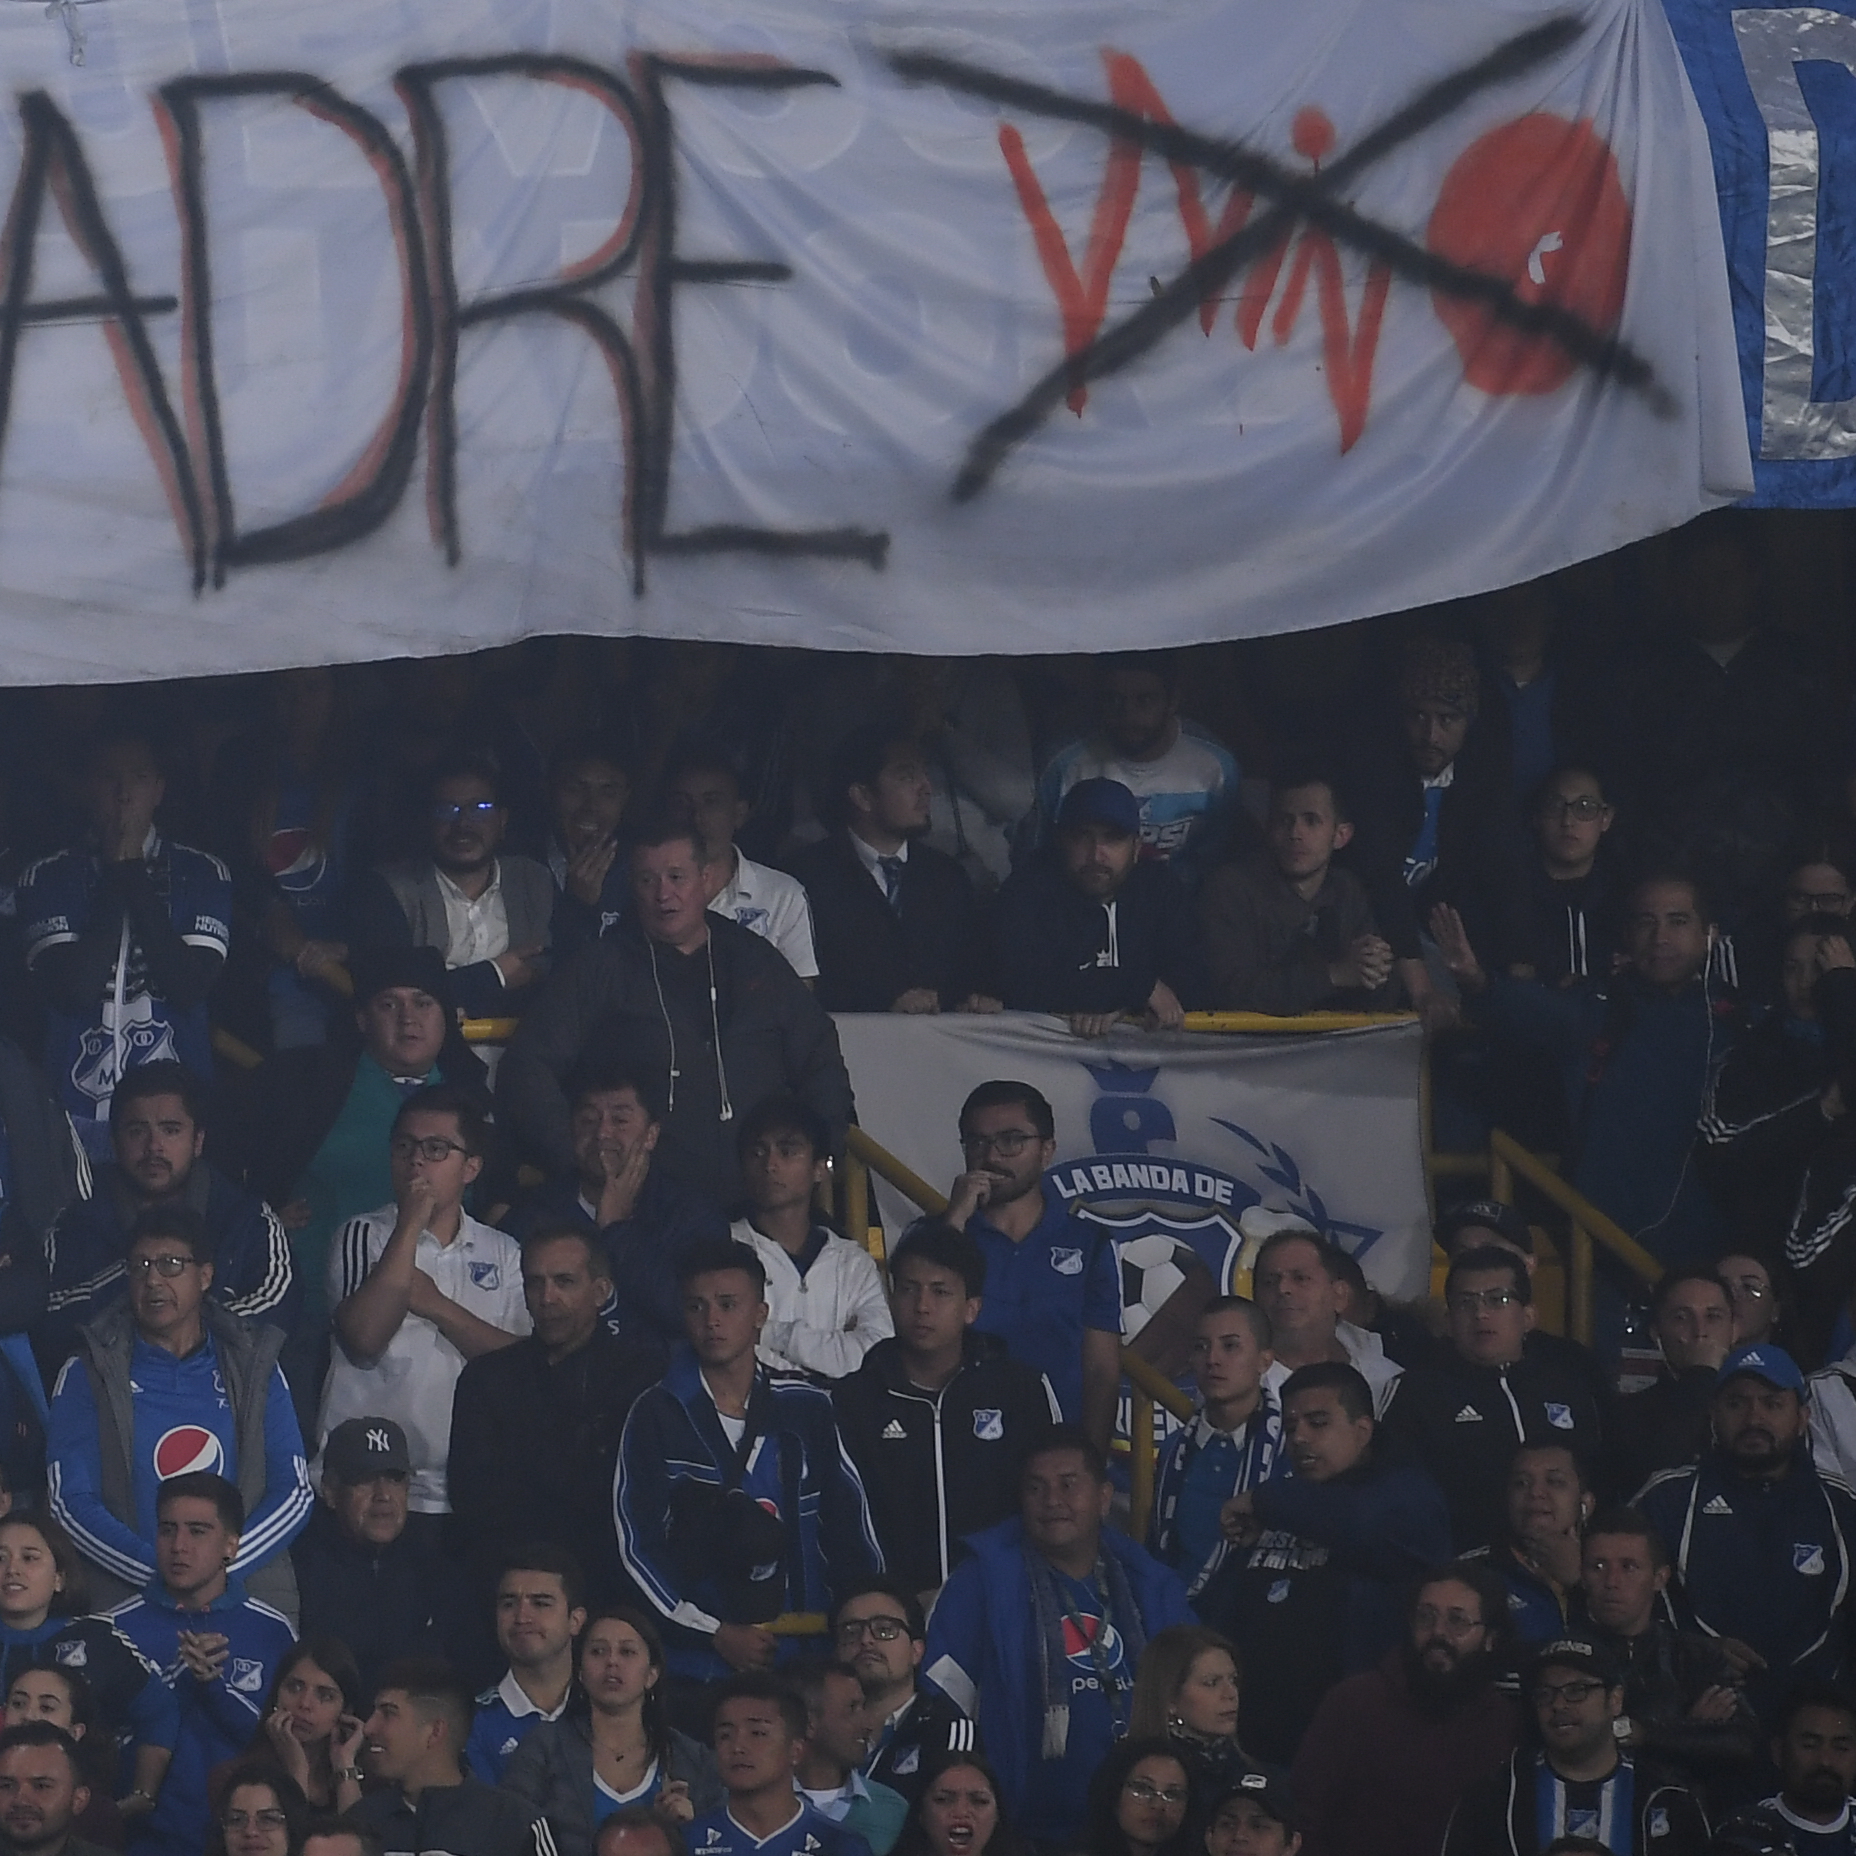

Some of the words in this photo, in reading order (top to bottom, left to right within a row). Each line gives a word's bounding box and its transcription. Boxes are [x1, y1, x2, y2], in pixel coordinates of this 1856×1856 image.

[1051, 1167, 1095, 1201] LA
[1090, 1162, 1191, 1195] BANDA
[1193, 1172, 1235, 1207] DE
